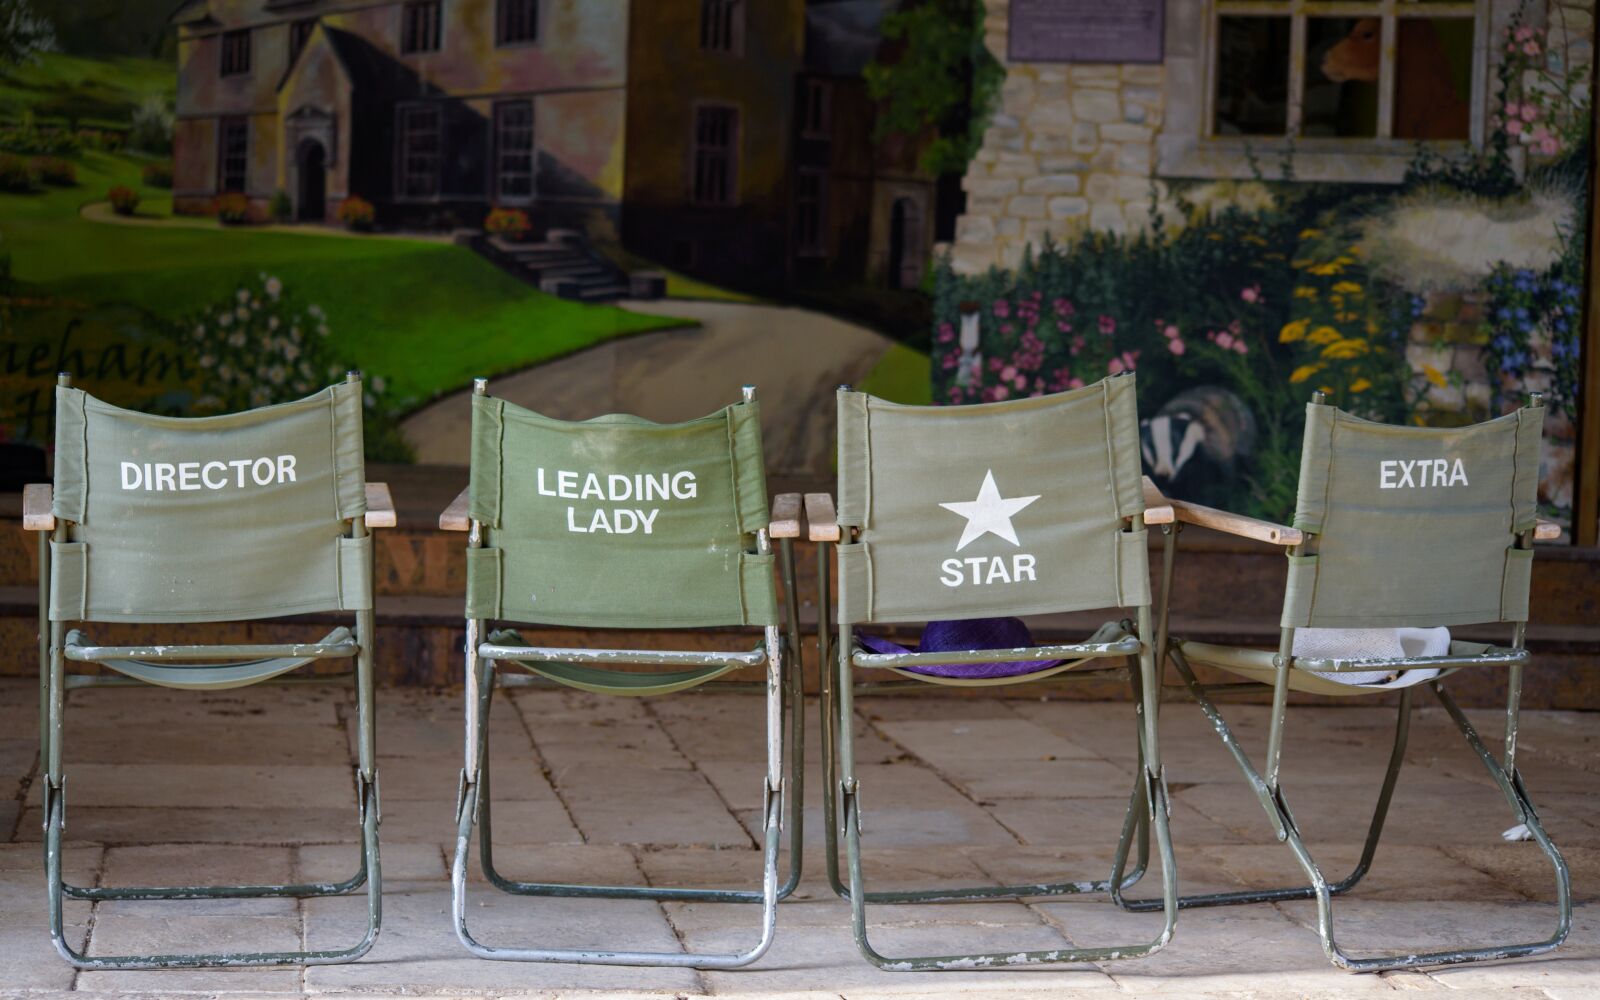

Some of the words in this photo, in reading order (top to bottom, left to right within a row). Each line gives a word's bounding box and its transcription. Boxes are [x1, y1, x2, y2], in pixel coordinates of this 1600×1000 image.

[120, 454, 297, 492] DIRECTOR
[537, 467, 697, 502] LEADING
[1379, 457, 1469, 489] EXTRA
[567, 506, 660, 535] LADY
[939, 553, 1037, 588] STAR
